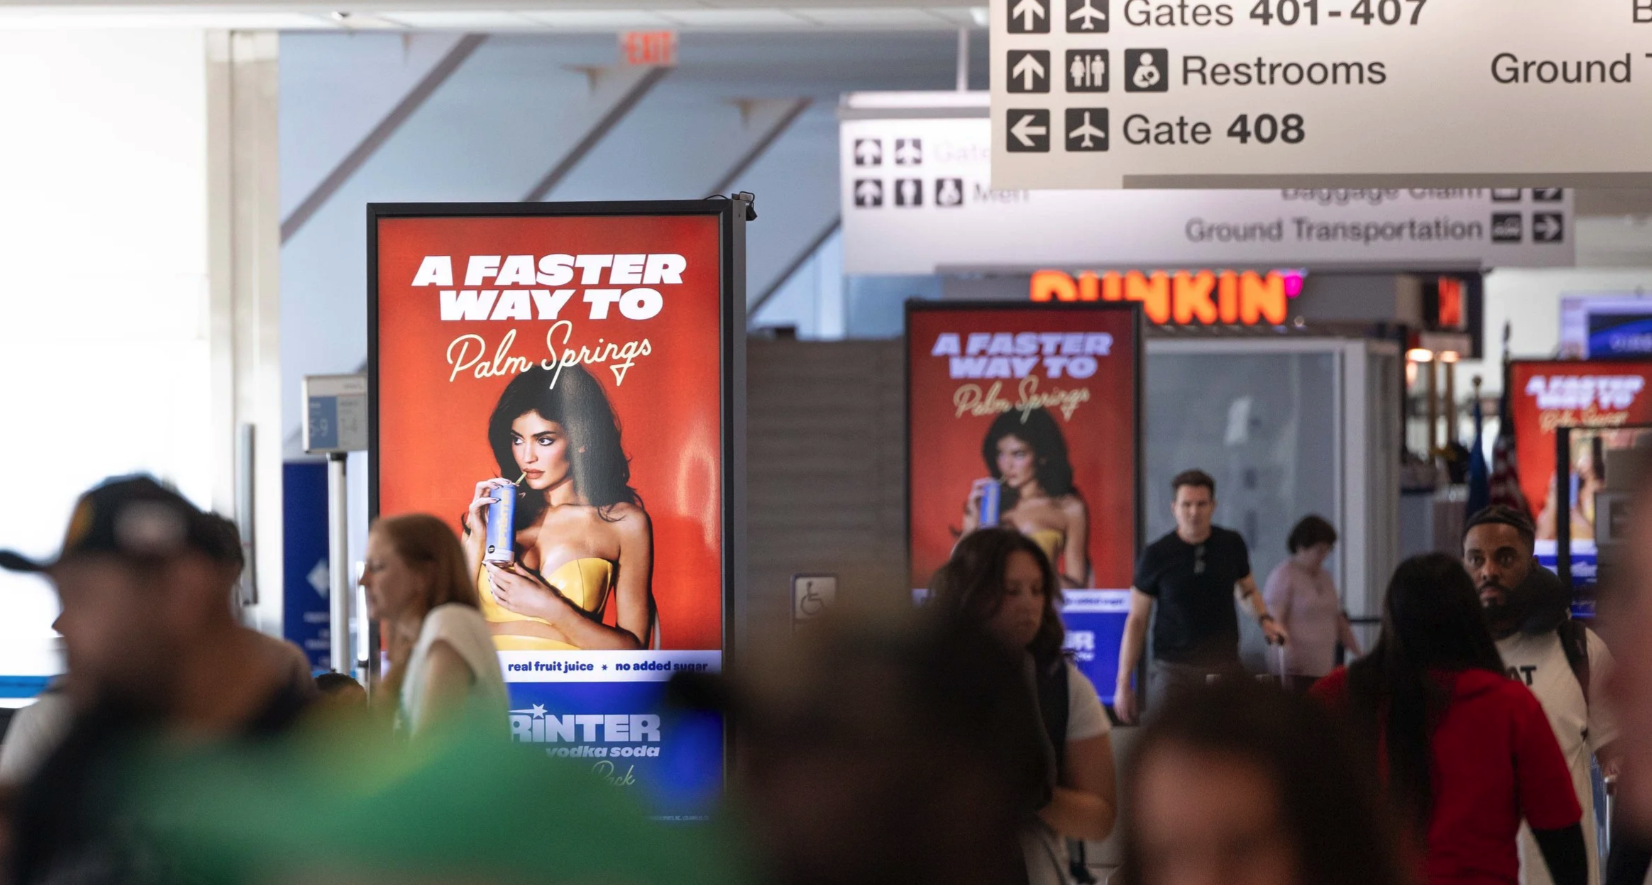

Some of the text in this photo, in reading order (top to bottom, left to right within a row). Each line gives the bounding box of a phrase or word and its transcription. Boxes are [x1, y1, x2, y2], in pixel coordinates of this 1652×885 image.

[1124, 0, 1234, 27] Gates
[1183, 55, 1387, 86] Restrooms
[1490, 52, 1631, 84] Ground
[1123, 113, 1306, 146] Gate 408
[1185, 216, 1483, 247] Ground Transportation
[411, 253, 687, 286] A FASTER
[440, 287, 664, 321] WAY TO
[447, 320, 652, 390] Palm Springs
[931, 332, 1114, 357] A FASTER
[949, 355, 1098, 379] WAY TO
[954, 374, 1090, 424] Palm Springs
[508, 661, 532, 672] real
[534, 660, 562, 672] fruit
[563, 661, 595, 675] juice
[615, 662, 631, 672] no
[633, 660, 671, 672] added
[508, 712, 661, 742] RINTER
[547, 744, 660, 758] vodka soda
